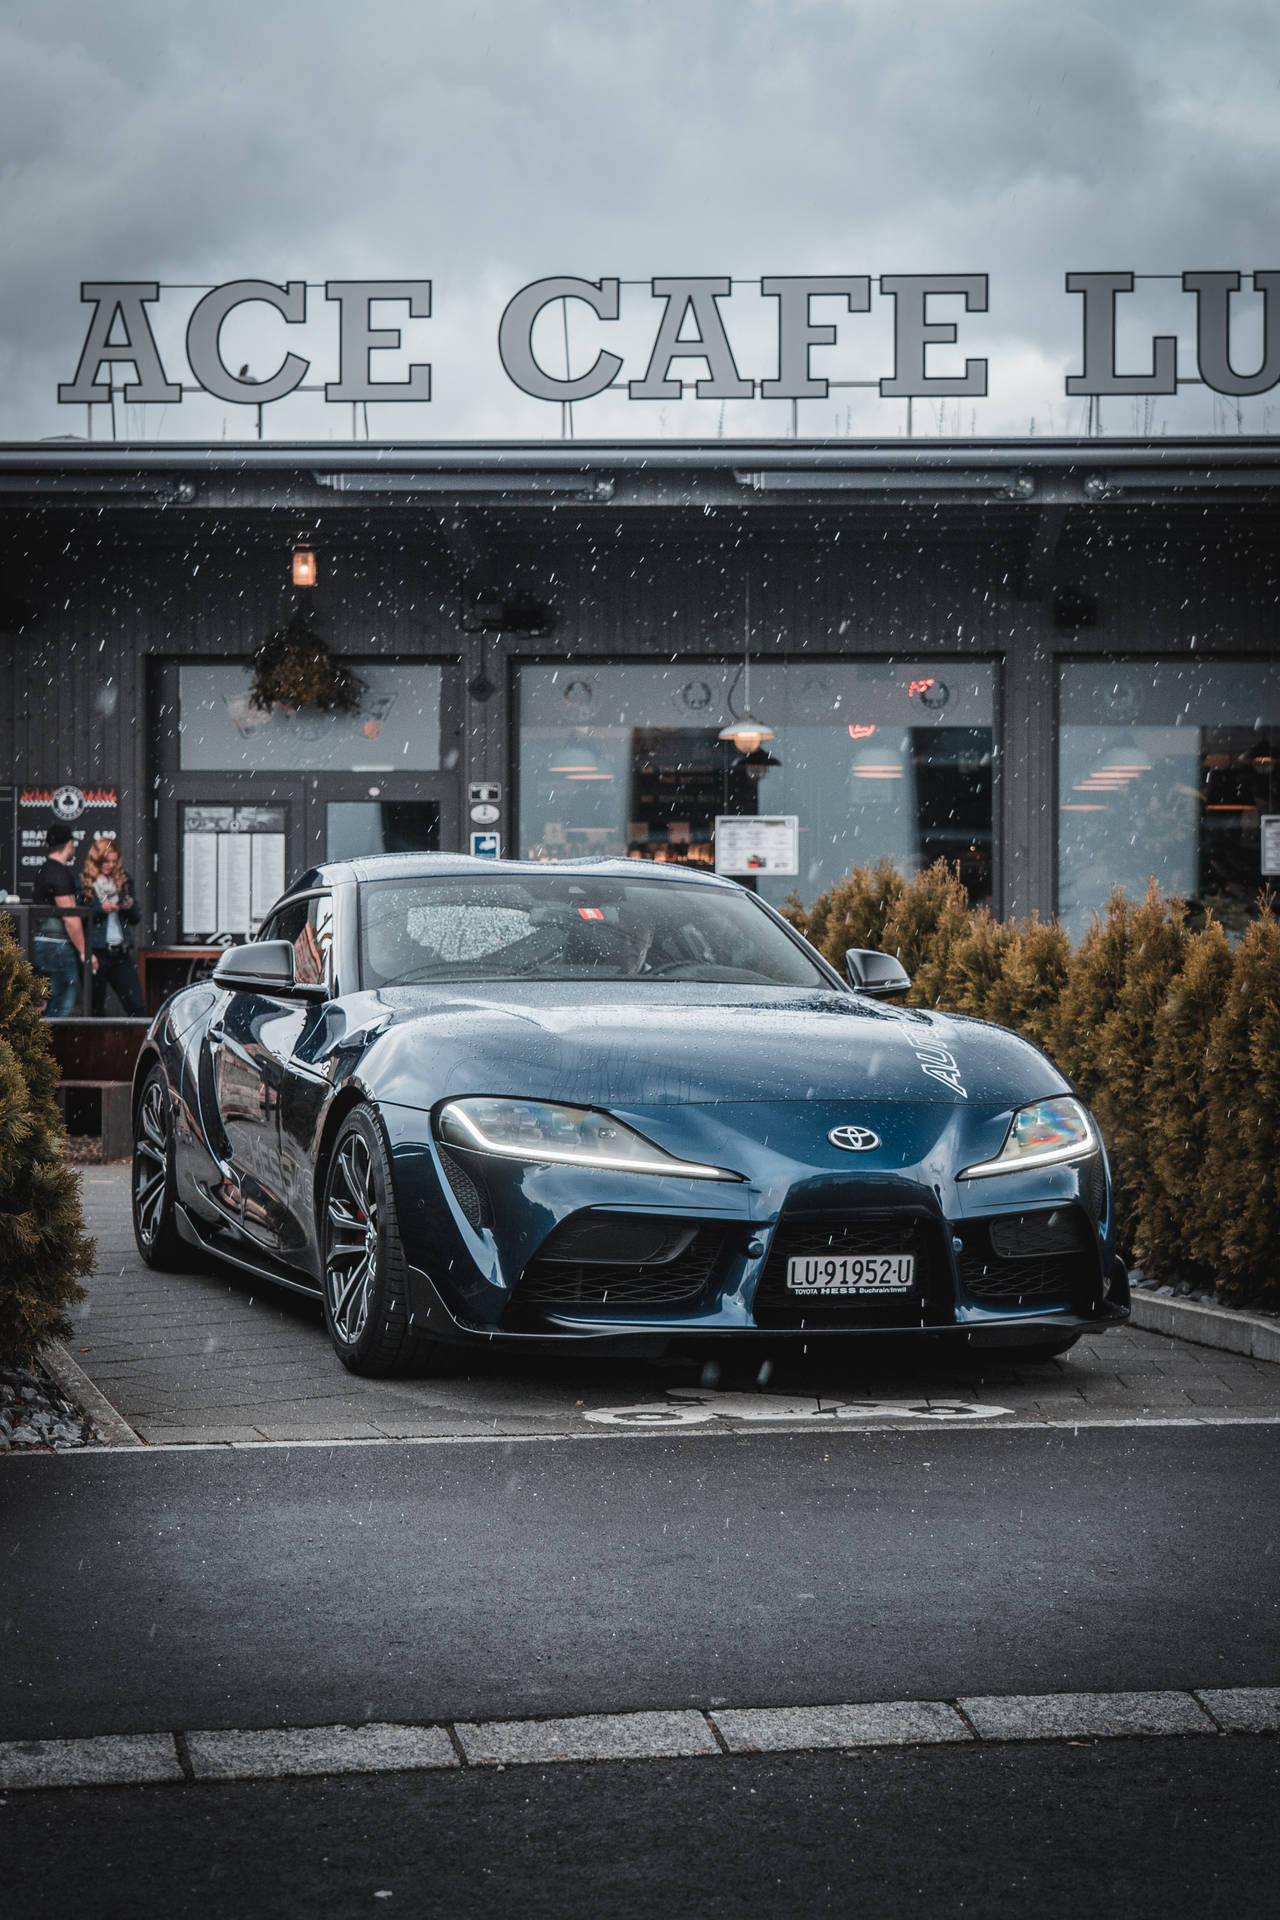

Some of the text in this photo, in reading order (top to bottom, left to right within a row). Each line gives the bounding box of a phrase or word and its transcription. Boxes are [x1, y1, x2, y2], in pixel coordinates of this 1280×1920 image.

[58, 270, 1280, 404] ACE CAFE LU
